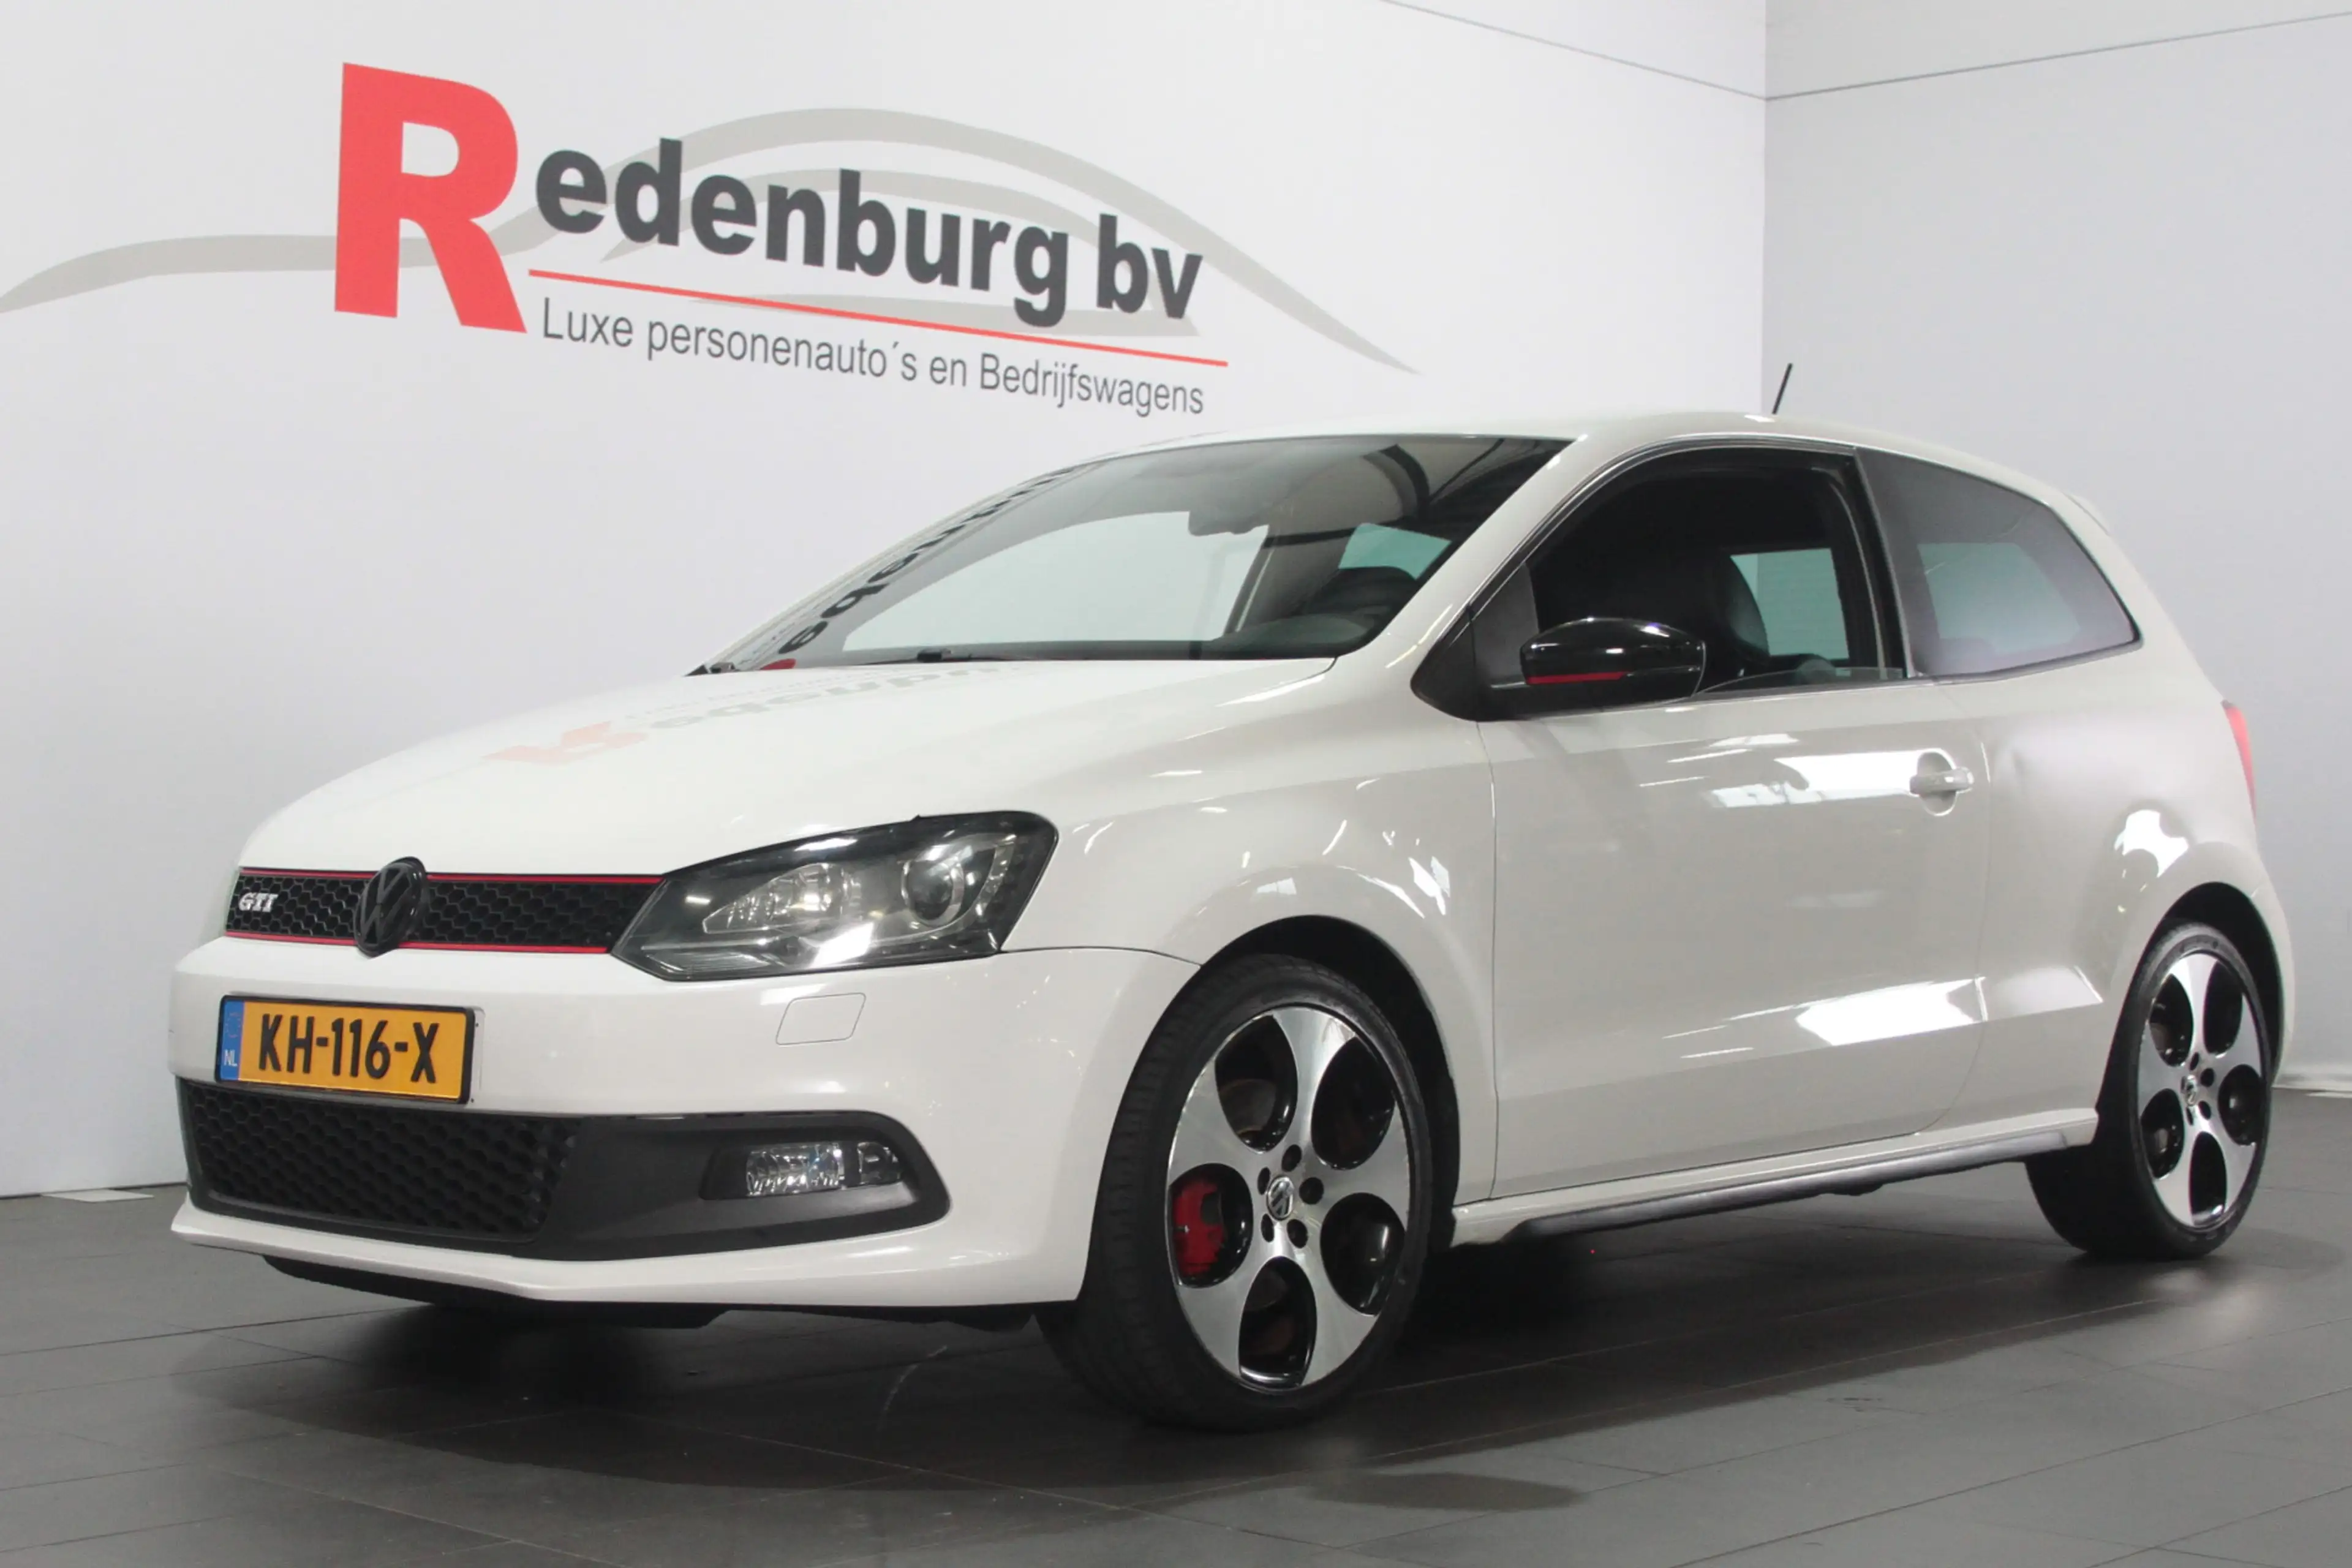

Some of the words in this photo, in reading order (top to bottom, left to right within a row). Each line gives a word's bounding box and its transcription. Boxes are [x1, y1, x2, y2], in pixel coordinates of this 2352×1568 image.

[335, 63, 1068, 333] Redenburg
[1097, 214, 1203, 320] bv
[543, 297, 633, 348] Luxe
[929, 356, 967, 386] en
[980, 353, 1204, 418] Bedrijfswagens
[239, 892, 279, 912] GTI
[224, 1049, 238, 1066] NL
[259, 1014, 439, 1084] KH-116-X
